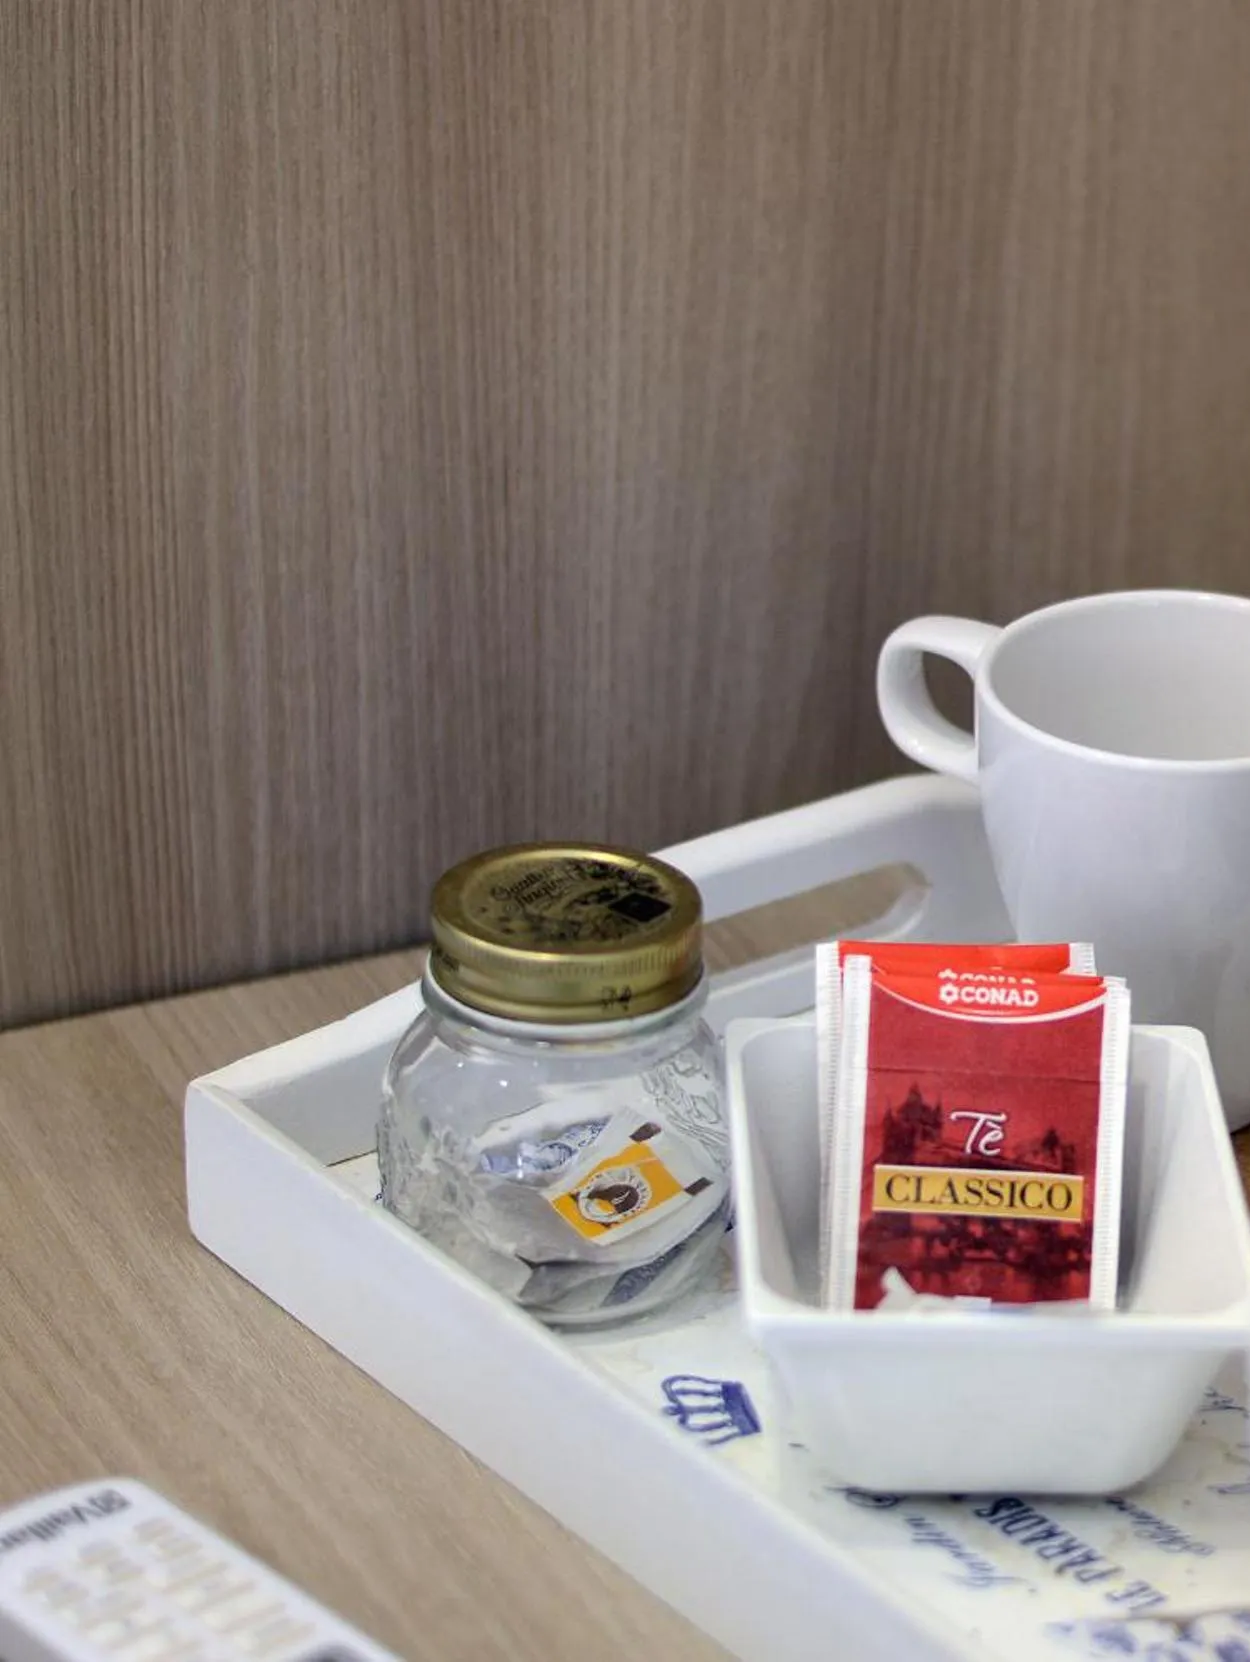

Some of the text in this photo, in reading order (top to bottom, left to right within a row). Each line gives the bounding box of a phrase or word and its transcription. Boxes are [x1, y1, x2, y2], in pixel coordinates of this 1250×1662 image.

[960, 985, 1039, 1007] CONAD
[950, 1110, 1007, 1156] Tè
[885, 1173, 1073, 1211] CLASSICO
[974, 1497, 1125, 1583] PARADIS
